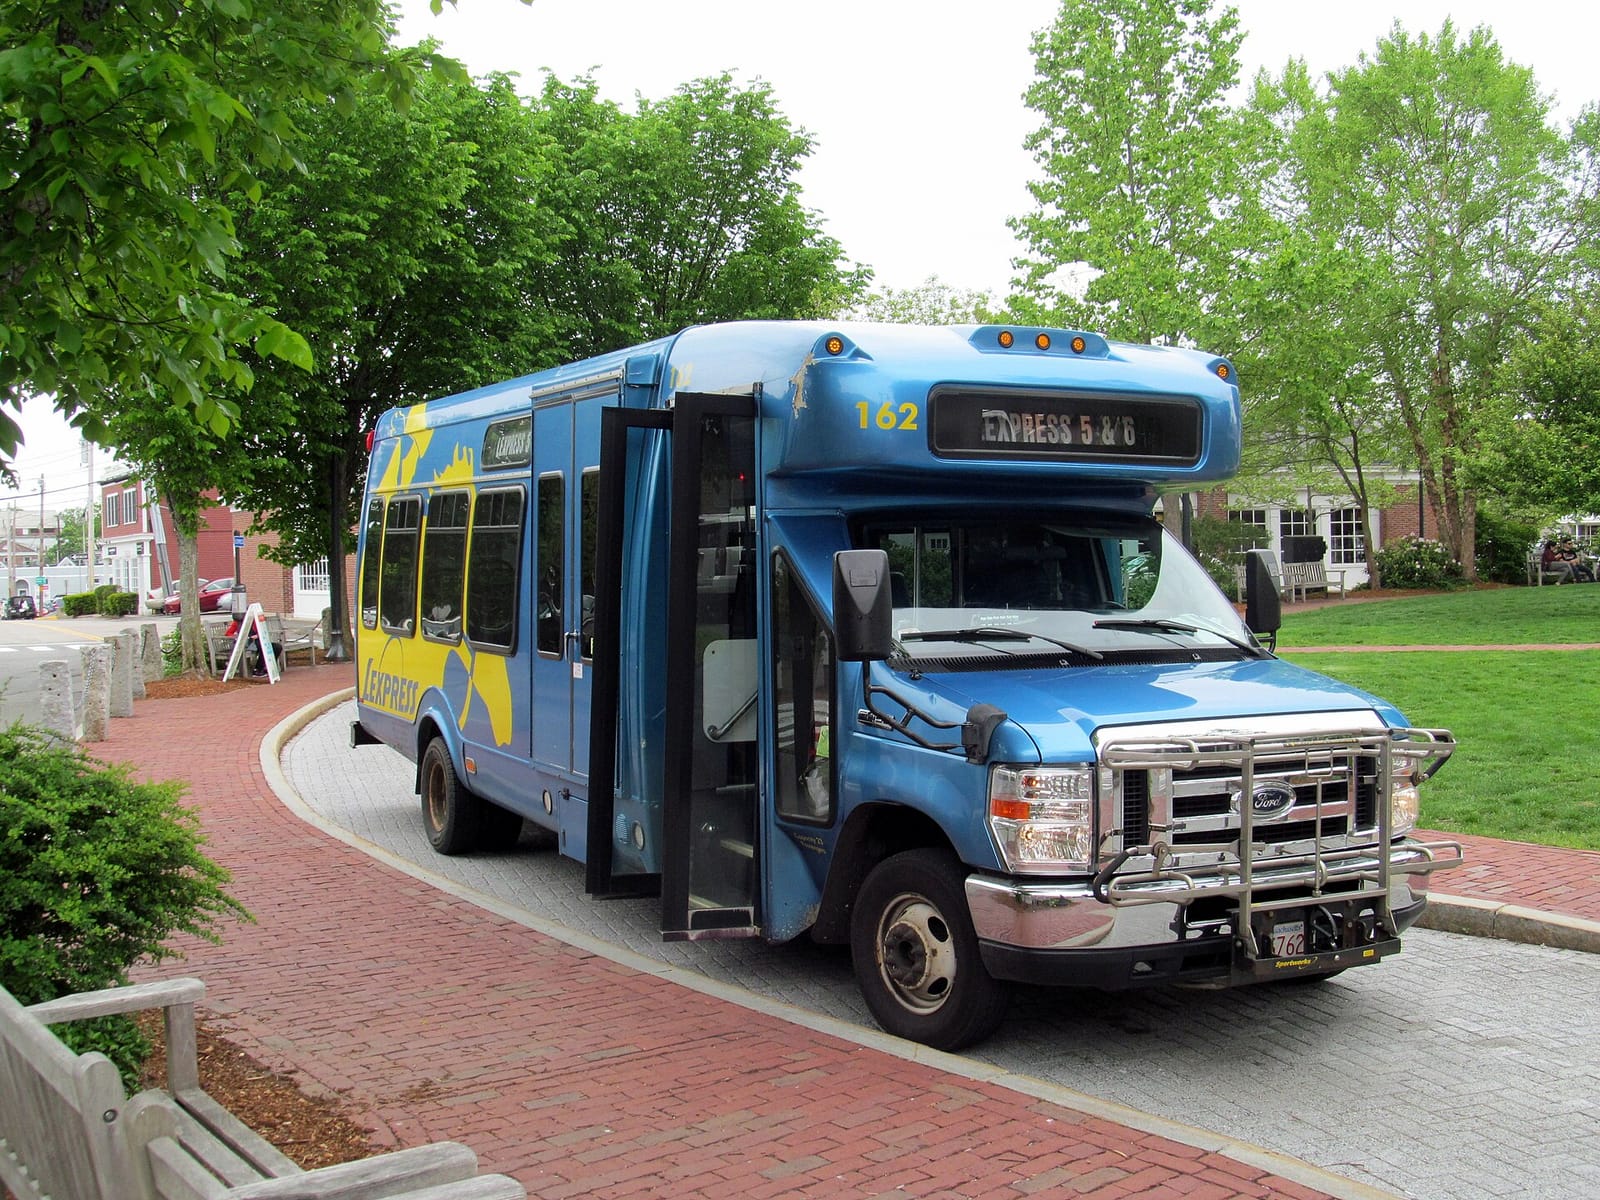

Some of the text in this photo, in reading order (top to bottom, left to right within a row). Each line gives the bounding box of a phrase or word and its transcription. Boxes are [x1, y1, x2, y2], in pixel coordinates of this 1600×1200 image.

[855, 401, 918, 430] 162
[1080, 415, 1093, 445] 5
[1102, 415, 1115, 445] &
[1123, 415, 1136, 446] 6
[1254, 792, 1282, 808] Ford
